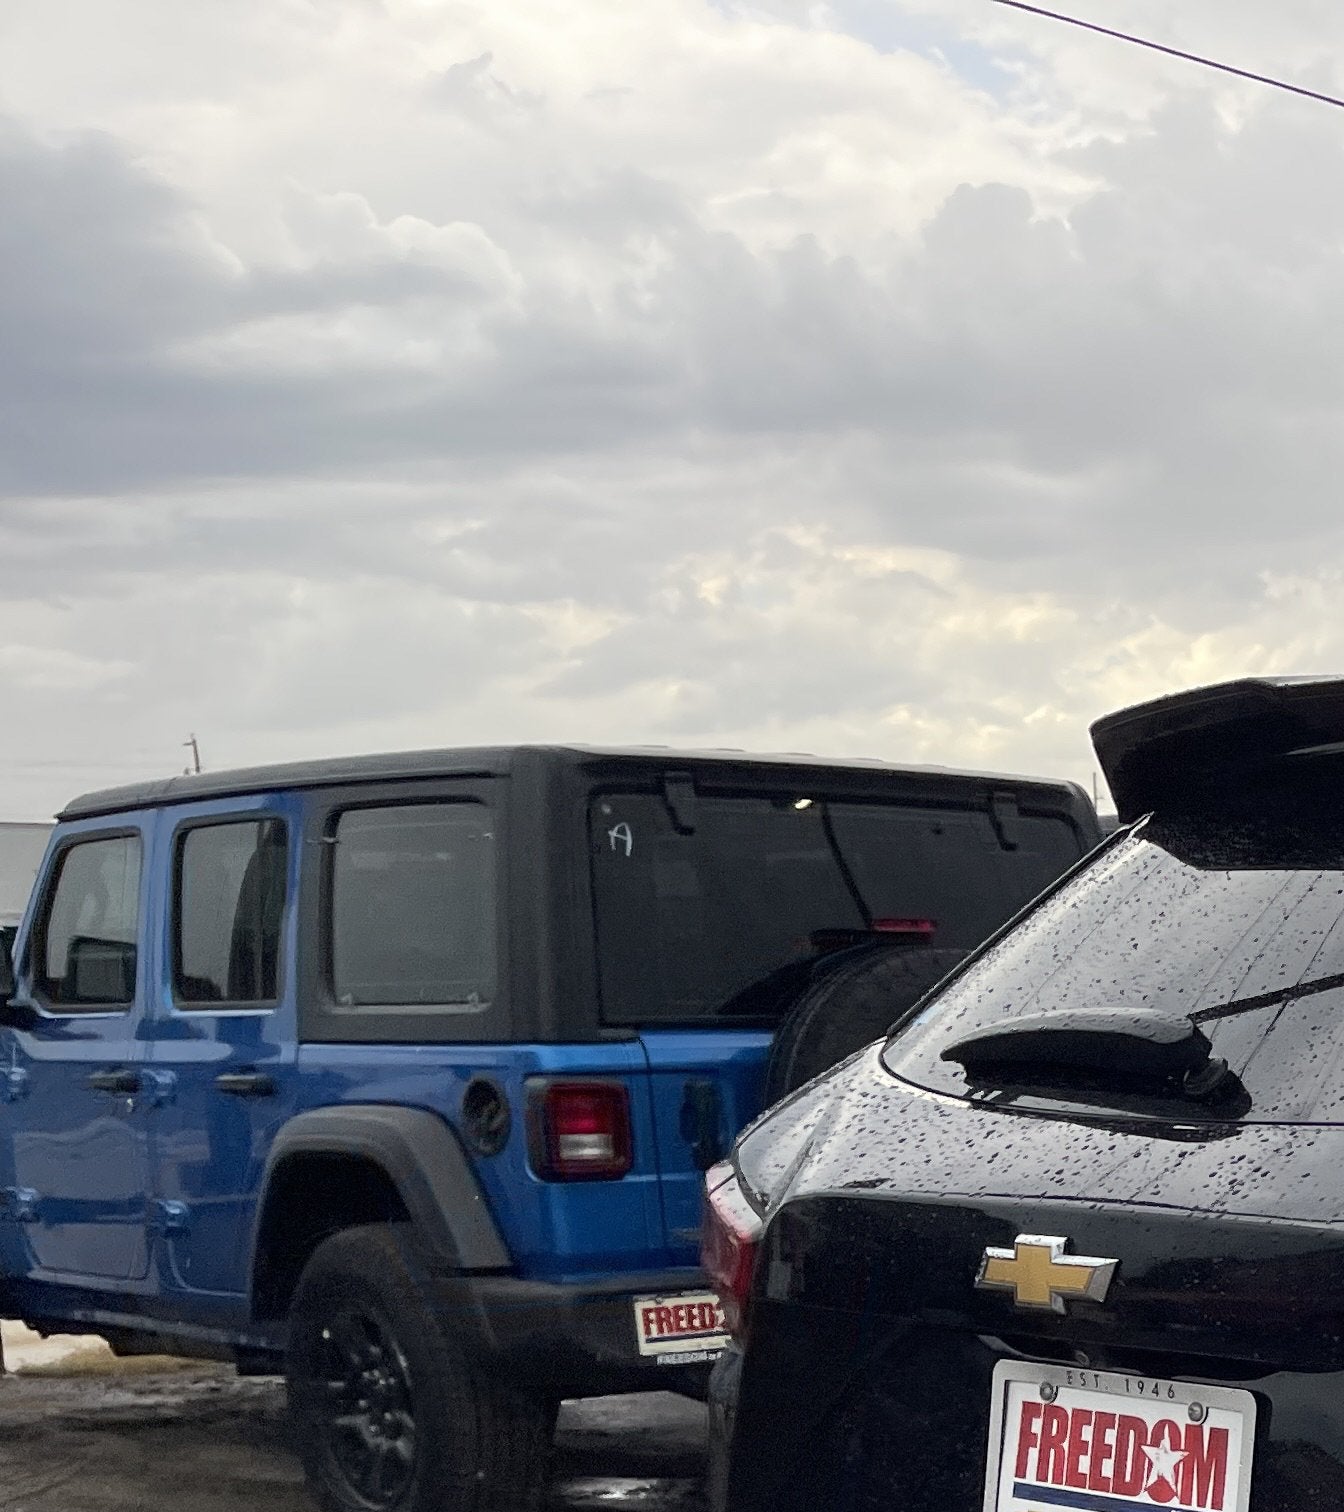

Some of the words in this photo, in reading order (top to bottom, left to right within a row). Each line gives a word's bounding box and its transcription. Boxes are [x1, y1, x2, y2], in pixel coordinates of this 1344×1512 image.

[642, 1303, 726, 1335] FREED
[1124, 1378, 1176, 1399] 1946
[1015, 1401, 1229, 1511] FREEDOM
